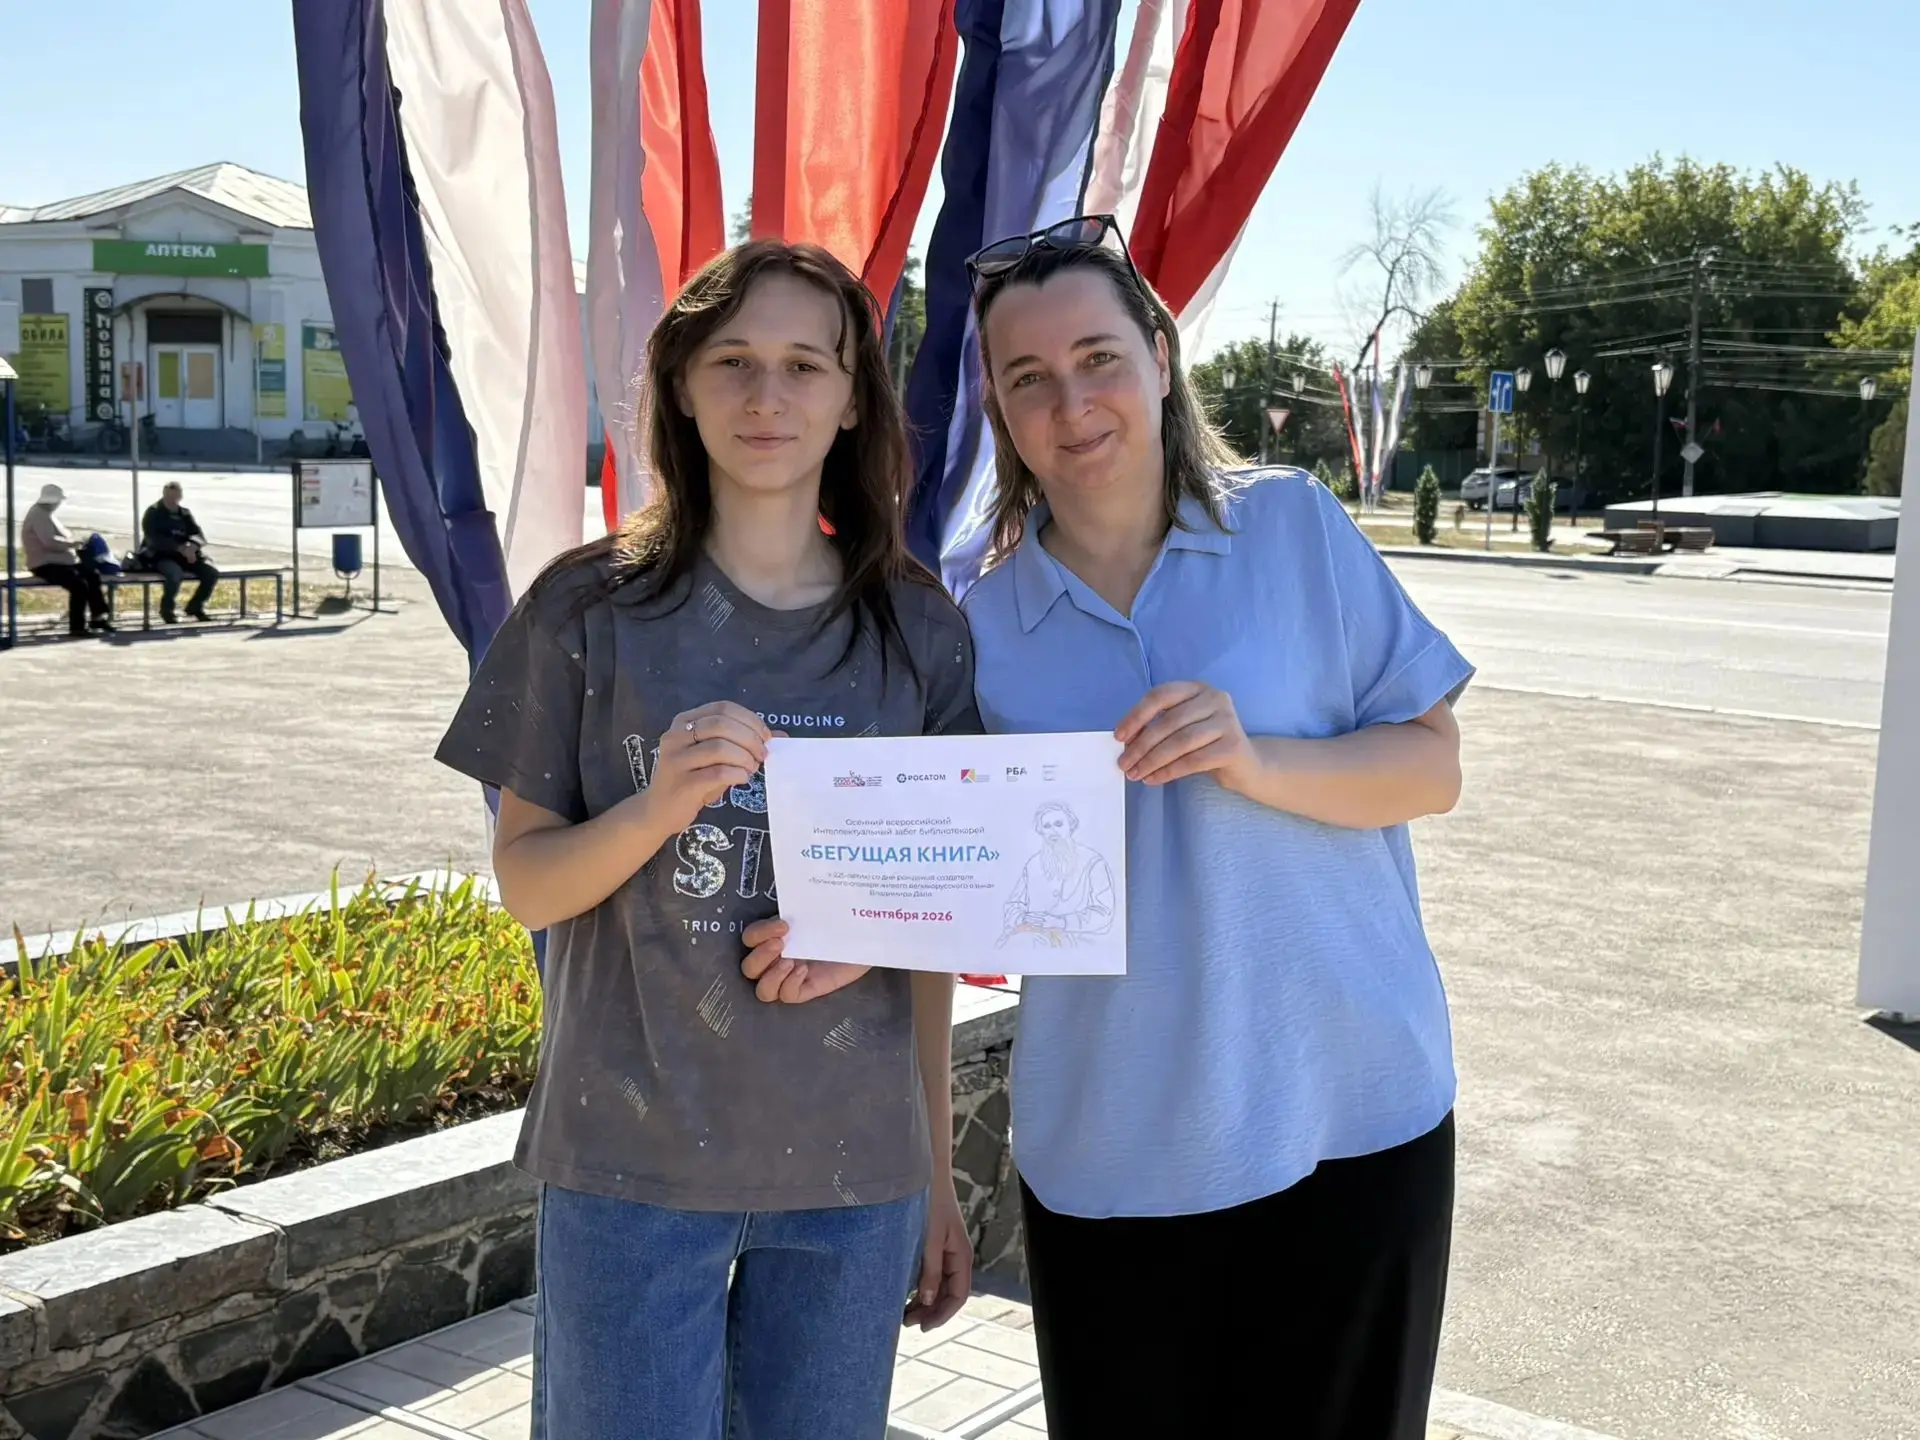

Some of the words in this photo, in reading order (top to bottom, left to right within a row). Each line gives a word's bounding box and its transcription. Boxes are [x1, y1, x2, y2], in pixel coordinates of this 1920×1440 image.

[144, 243, 217, 258] АПТЕКА
[1006, 767, 1028, 776] РБА
[845, 817, 884, 826] Осенний
[886, 816, 952, 828] всероссийский
[800, 844, 911, 865] «БЕГУЩАЯ
[918, 845, 1000, 863] КНИГА»
[673, 823, 778, 901] ST
[851, 908, 857, 917] 1
[859, 908, 919, 922] сентября
[921, 910, 953, 922] 2026
[682, 919, 721, 932] TRIO
